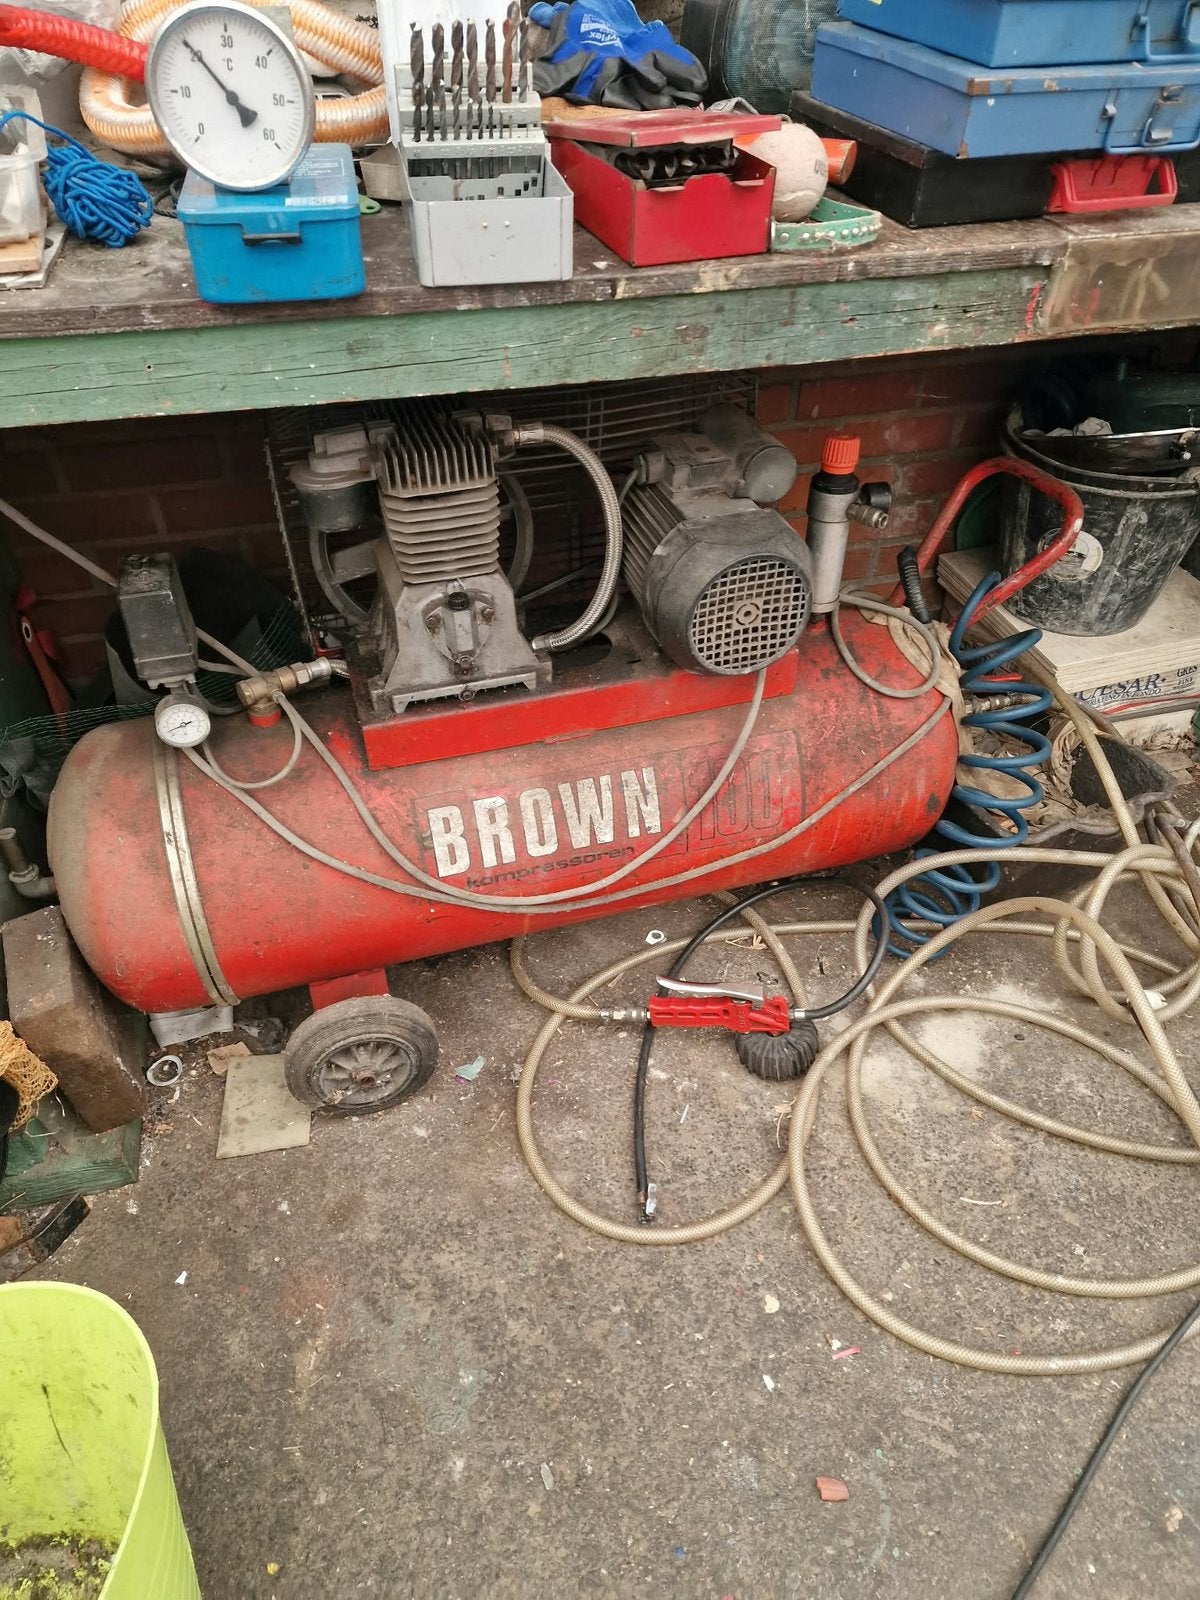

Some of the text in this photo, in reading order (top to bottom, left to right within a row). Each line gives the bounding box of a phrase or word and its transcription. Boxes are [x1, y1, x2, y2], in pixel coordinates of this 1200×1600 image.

[220, 35, 234, 49] 30
[255, 56, 268, 69] 40
[180, 85, 191, 99] 10
[273, 94, 285, 107] 50
[198, 122, 205, 135] 0
[263, 128, 275, 141] 60
[427, 766, 662, 878] BROWN
[466, 846, 635, 889] kompressoren
